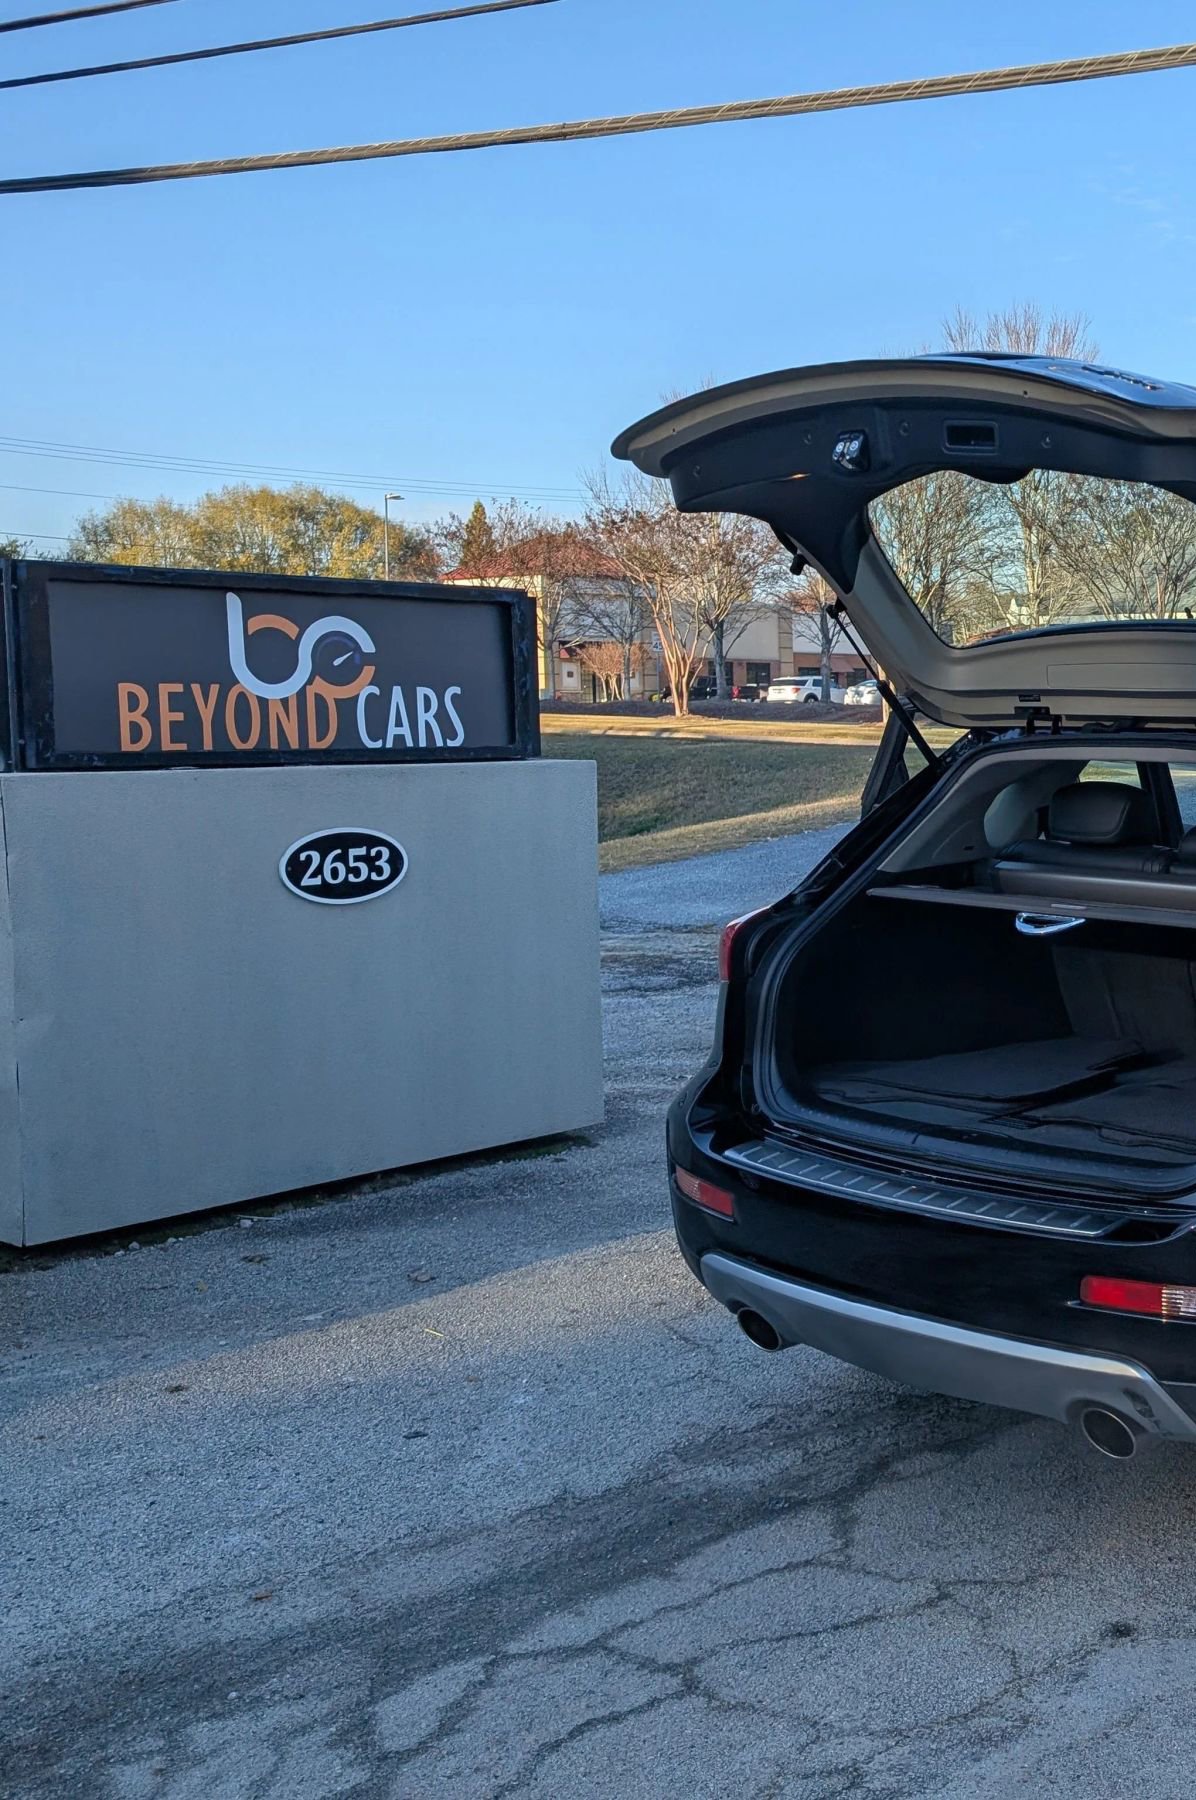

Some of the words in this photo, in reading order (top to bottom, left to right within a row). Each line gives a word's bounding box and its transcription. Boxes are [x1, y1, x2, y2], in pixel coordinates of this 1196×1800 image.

[117, 682, 339, 752] BEYOND
[356, 685, 466, 749] CARS
[299, 845, 392, 887] 2653
